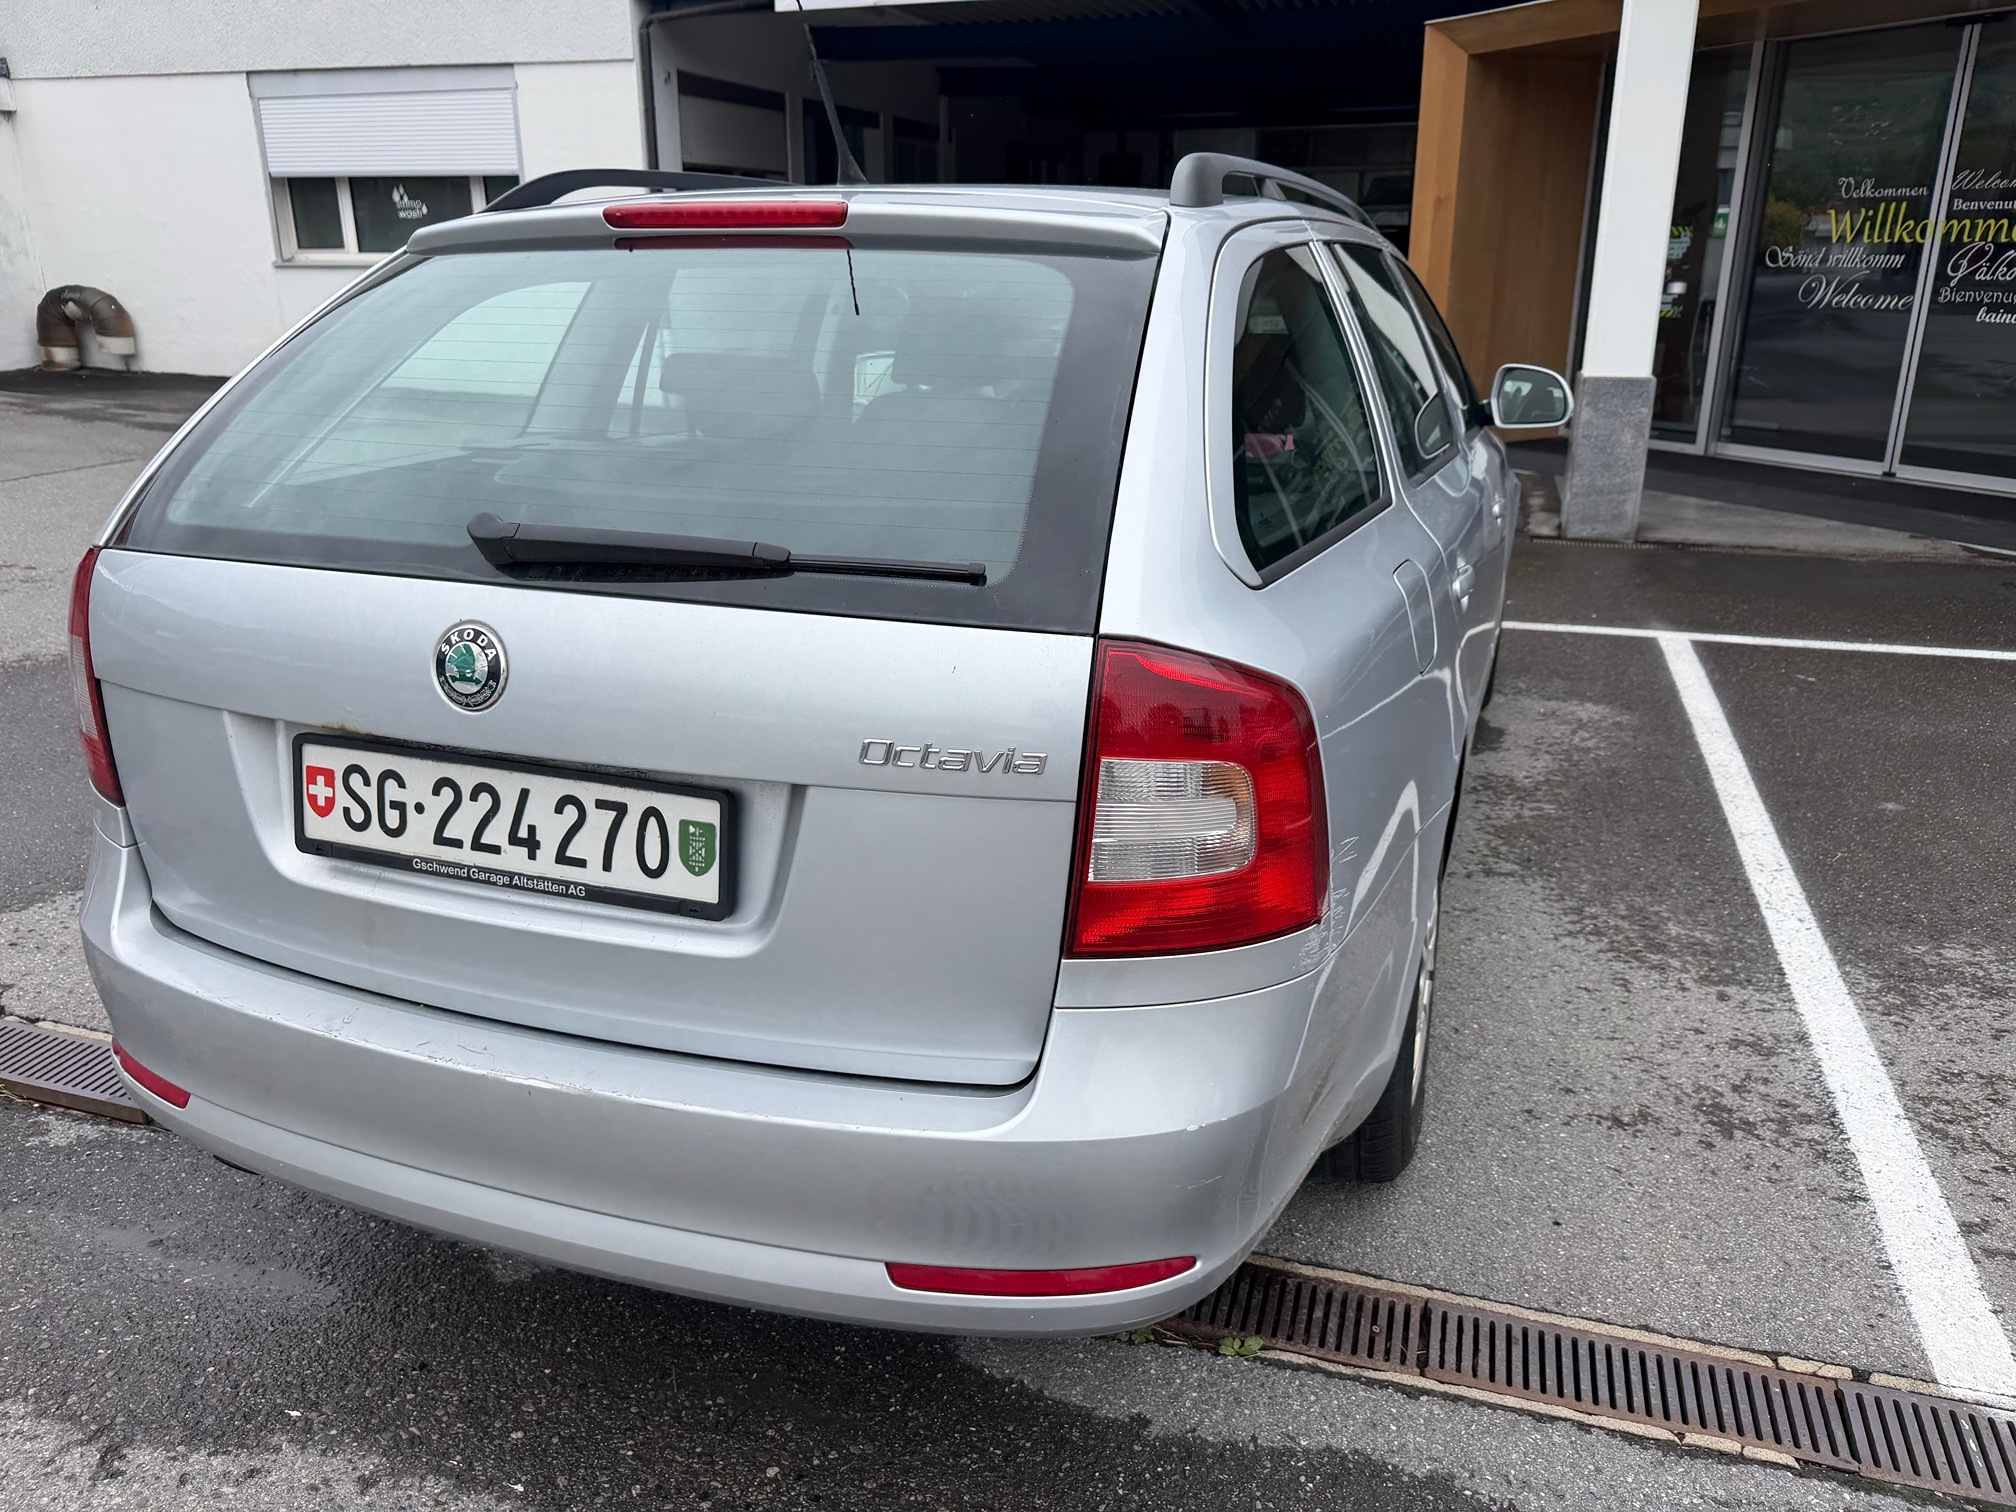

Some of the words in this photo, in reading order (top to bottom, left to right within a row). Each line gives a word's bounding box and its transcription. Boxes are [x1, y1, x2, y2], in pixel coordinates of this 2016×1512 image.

[1838, 177, 1928, 198] Velkommen
[397, 207, 423, 219] wash
[1827, 247, 1906, 269] willkomm
[1798, 270, 1914, 311] Welcome
[859, 738, 1048, 775] Octavia
[412, 858, 468, 877] Gschwend
[470, 868, 510, 885] Garage
[512, 875, 566, 894] Altstätten
[568, 884, 586, 897] AG
